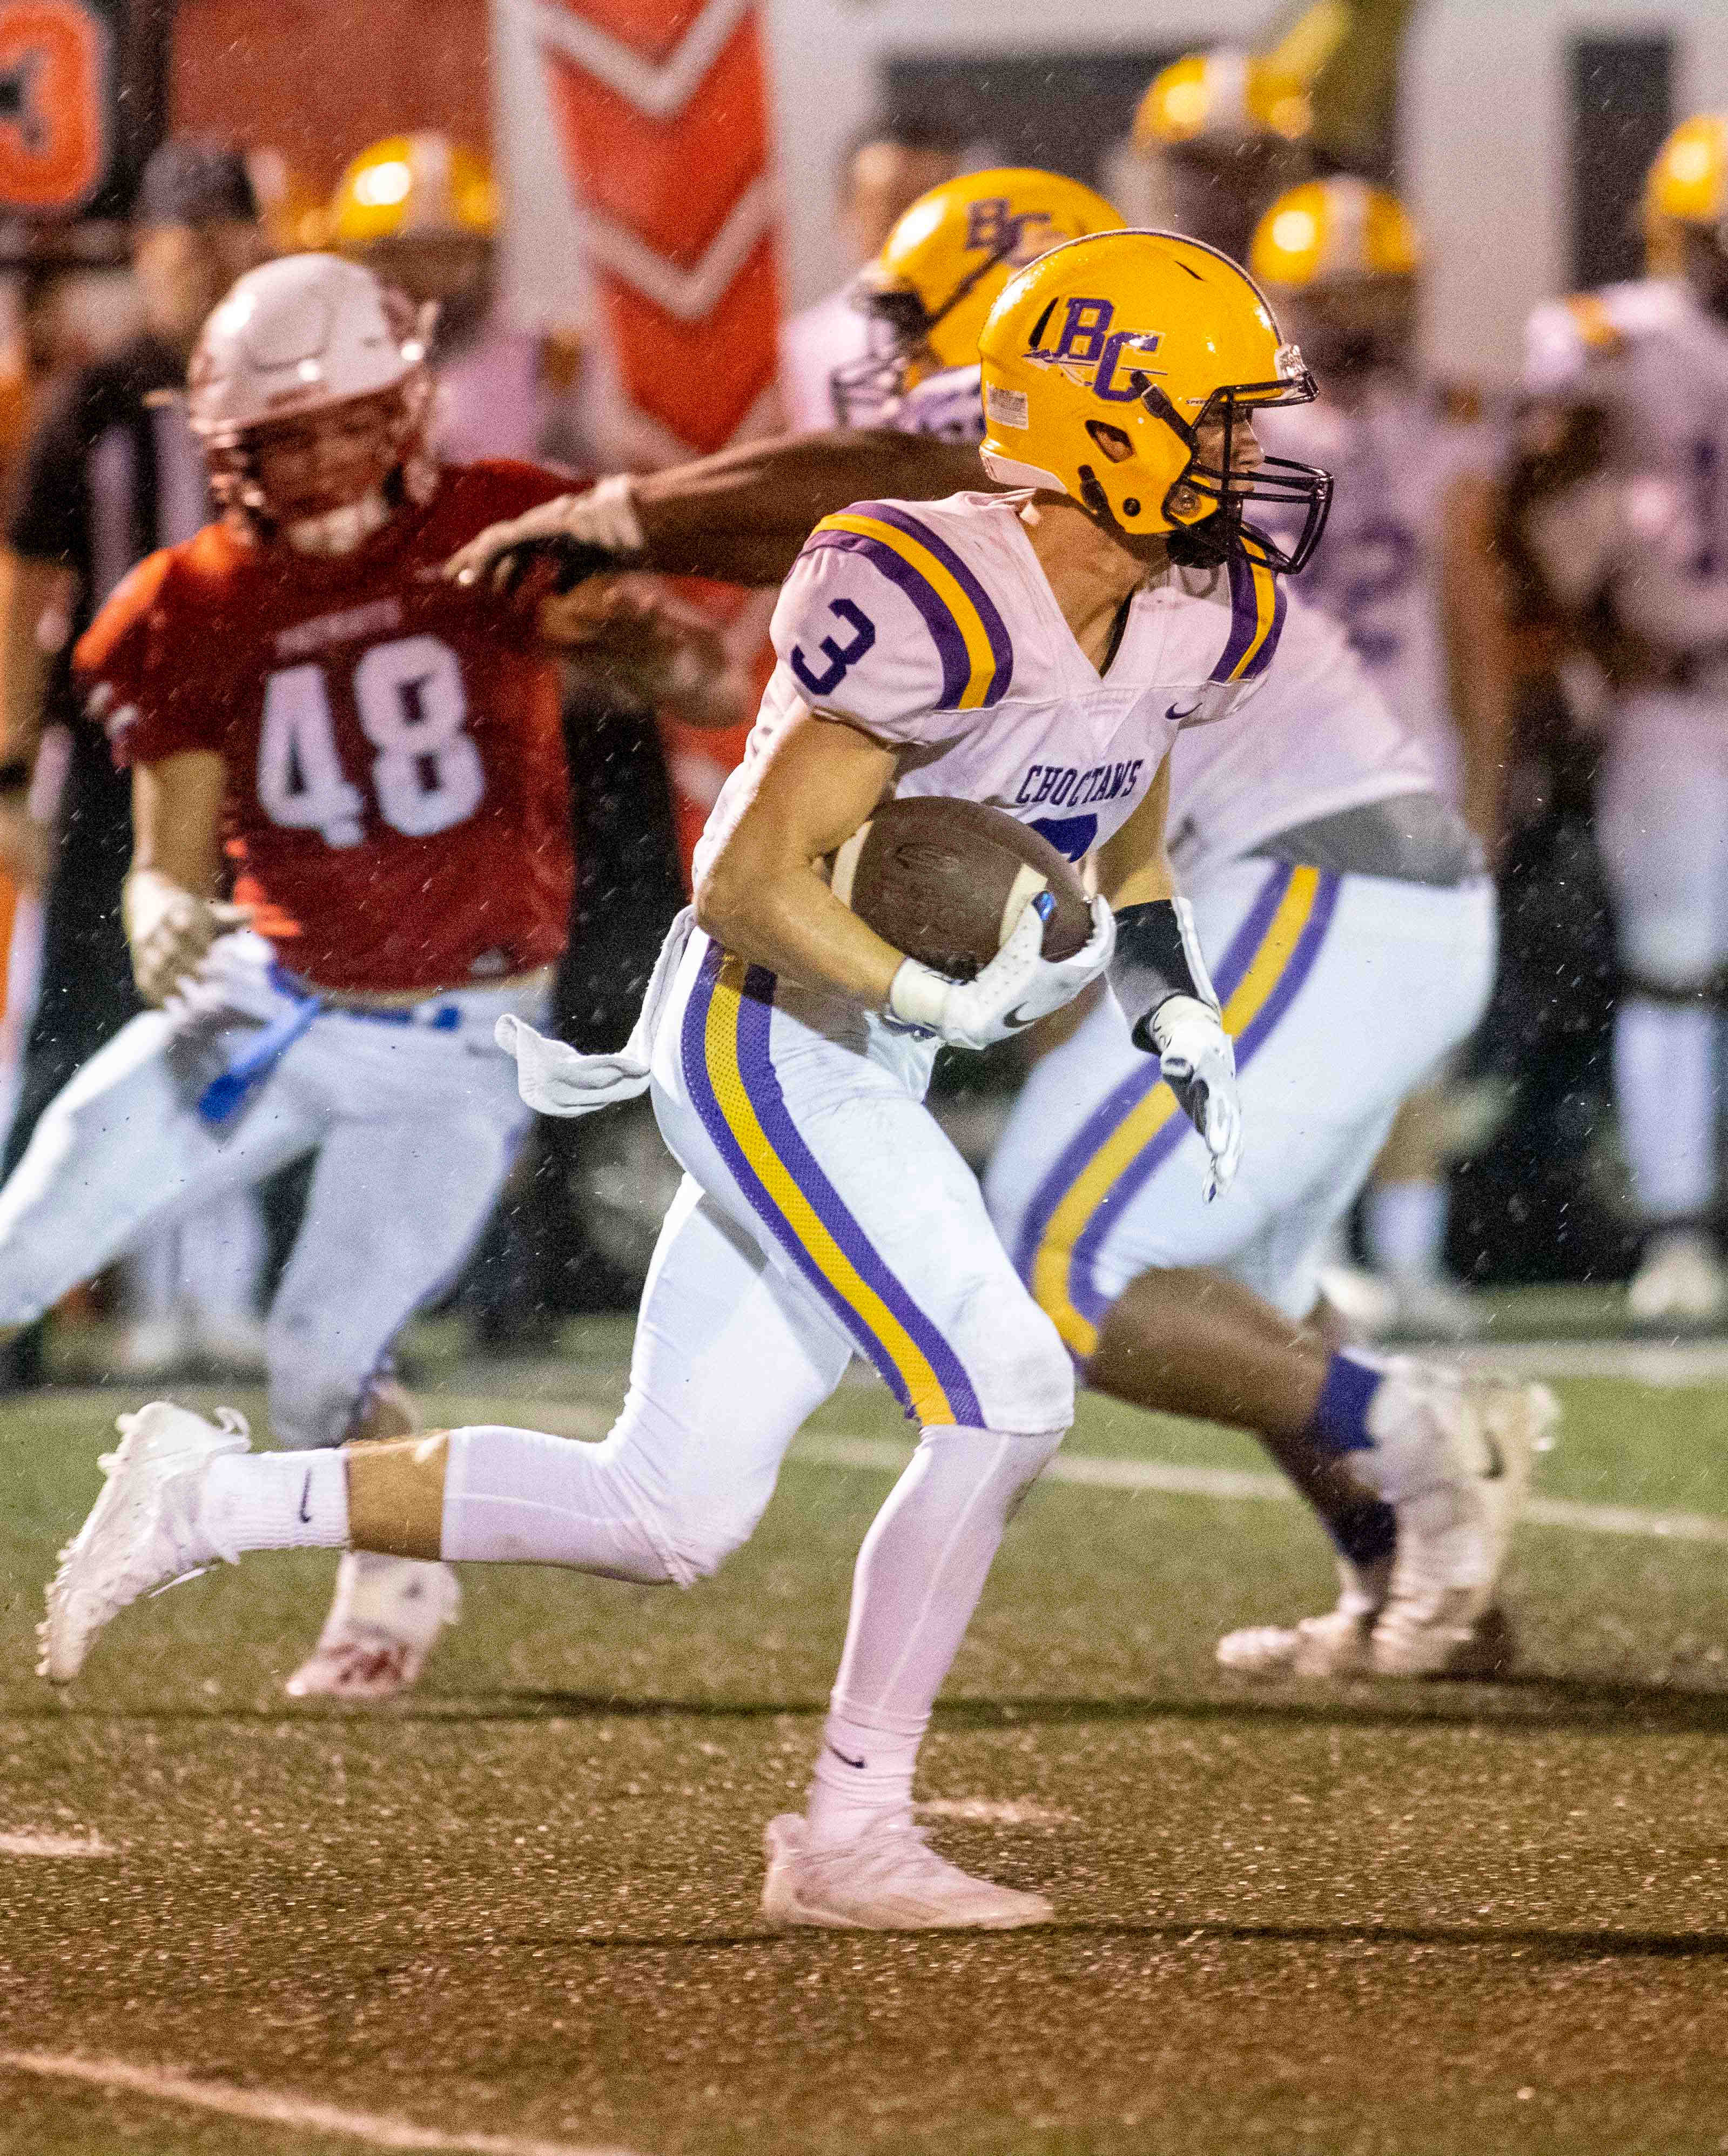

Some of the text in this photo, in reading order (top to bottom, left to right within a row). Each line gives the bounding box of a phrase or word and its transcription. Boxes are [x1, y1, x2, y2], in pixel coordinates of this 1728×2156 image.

[965, 197, 1059, 268] BC
[1056, 297, 1159, 402] BC
[791, 598, 876, 696] 3
[255, 632, 485, 848] 48
[1016, 759, 1144, 807] CHOCTAWS
